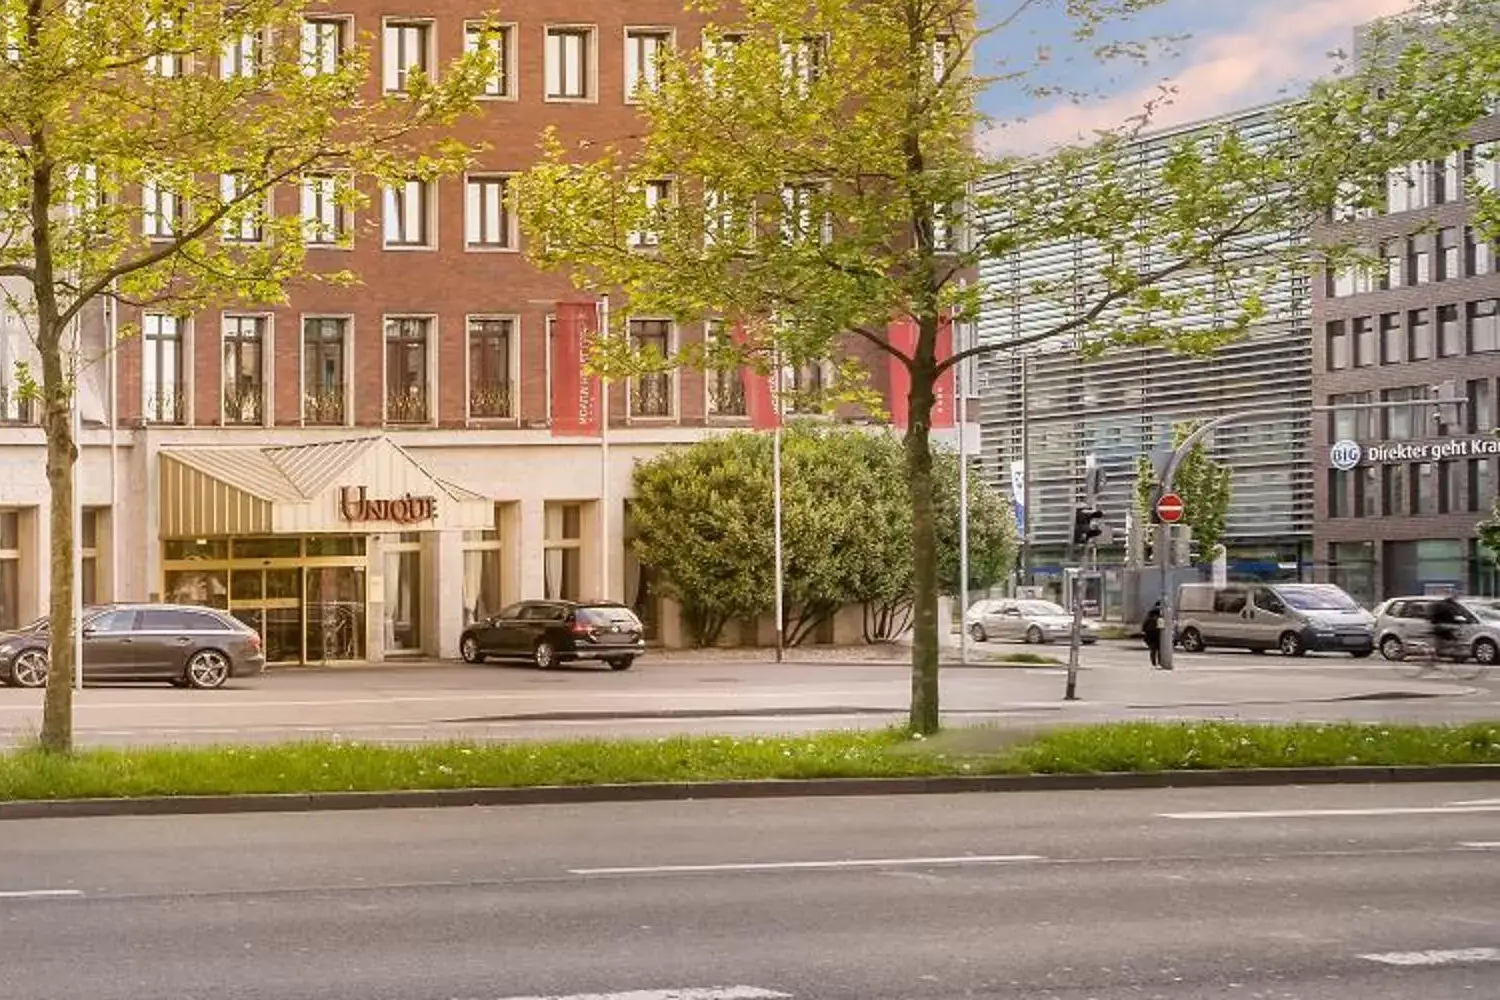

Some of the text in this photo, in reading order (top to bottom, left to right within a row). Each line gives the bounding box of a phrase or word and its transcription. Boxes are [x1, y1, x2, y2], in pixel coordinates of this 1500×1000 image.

[1334, 447, 1357, 463] BIG
[1368, 439, 1500, 461] Direkter geht Kra
